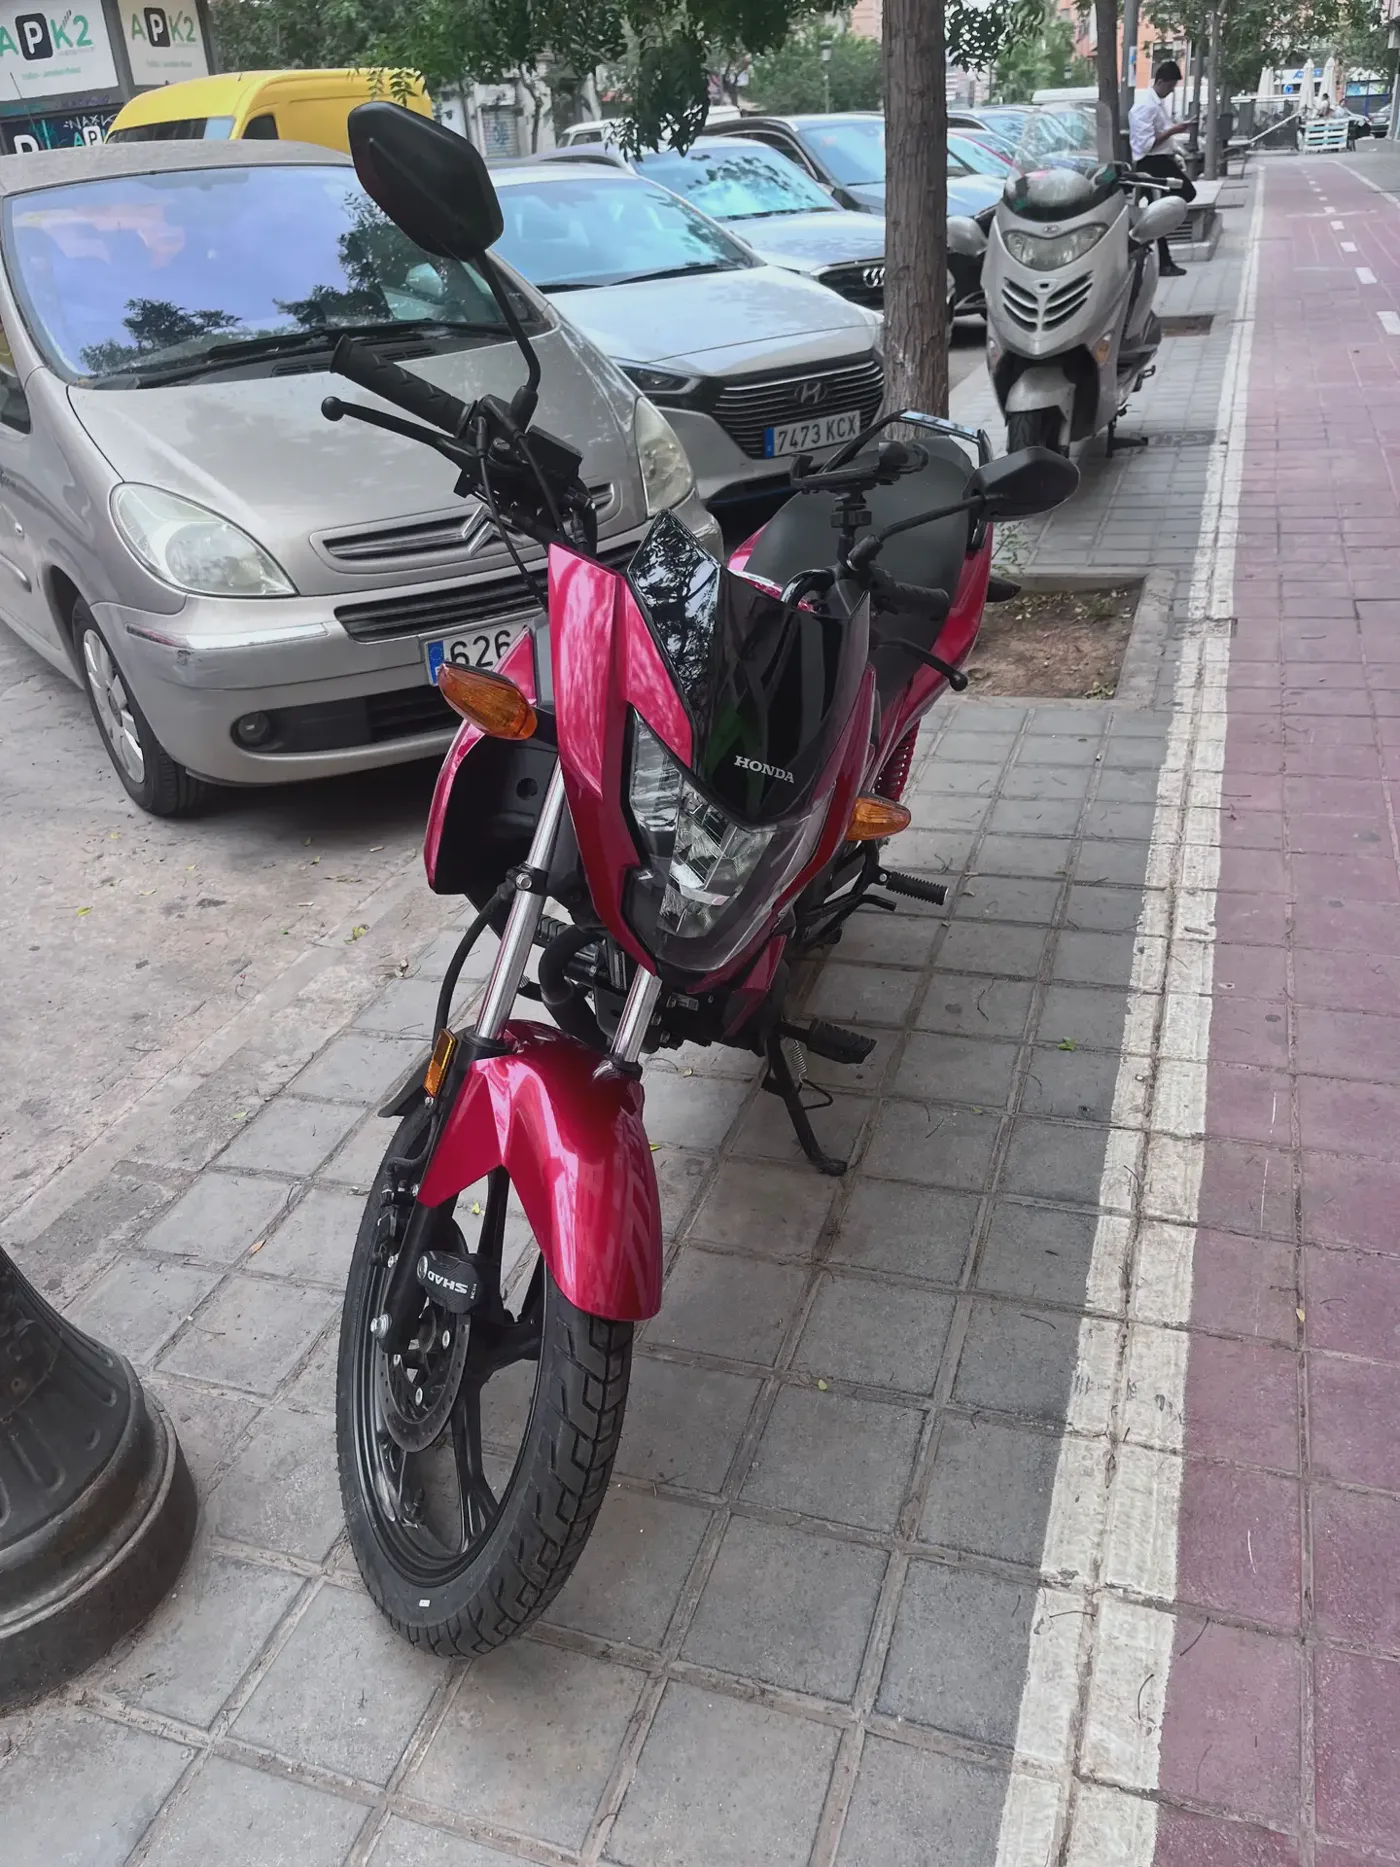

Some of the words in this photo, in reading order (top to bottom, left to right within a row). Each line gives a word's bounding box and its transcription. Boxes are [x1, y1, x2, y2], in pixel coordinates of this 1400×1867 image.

[132, 8, 197, 44] APK2
[778, 424, 821, 453] 7473
[826, 414, 857, 441] KCX
[450, 624, 528, 668] 626
[734, 755, 795, 784] HONDA
[427, 1270, 469, 1294] SHAD
